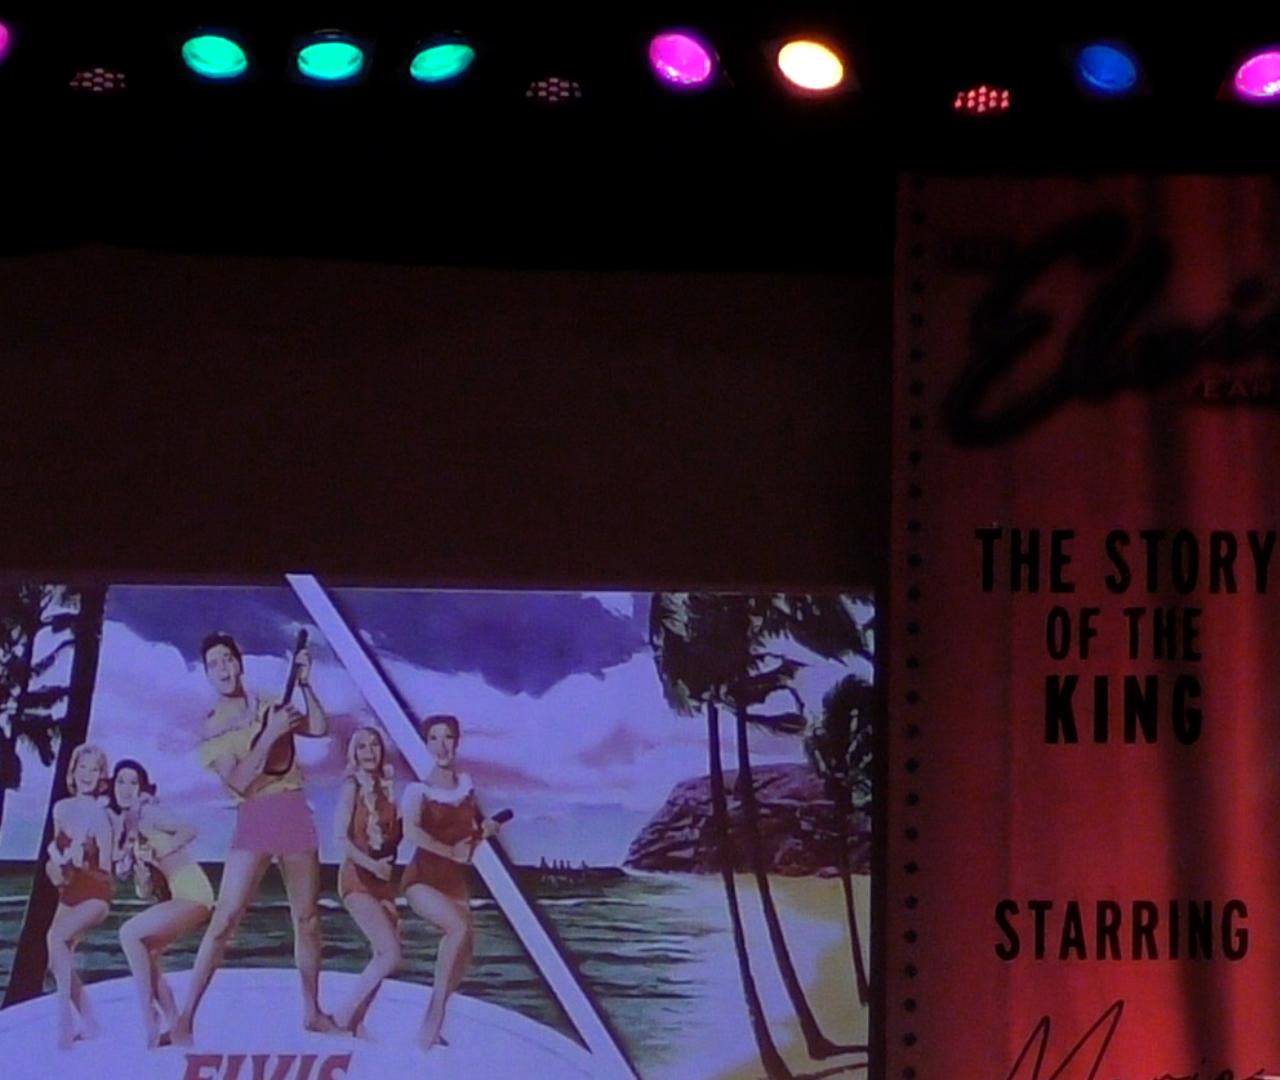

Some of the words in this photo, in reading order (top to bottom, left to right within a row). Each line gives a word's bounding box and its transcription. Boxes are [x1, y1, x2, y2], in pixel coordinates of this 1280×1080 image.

[976, 528, 1075, 593] THE
[1105, 529, 1277, 594] STORY
[1046, 606, 1101, 660] OF
[1123, 607, 1202, 662] THE
[1045, 674, 1203, 744] KING
[994, 899, 1249, 961] STARRING
